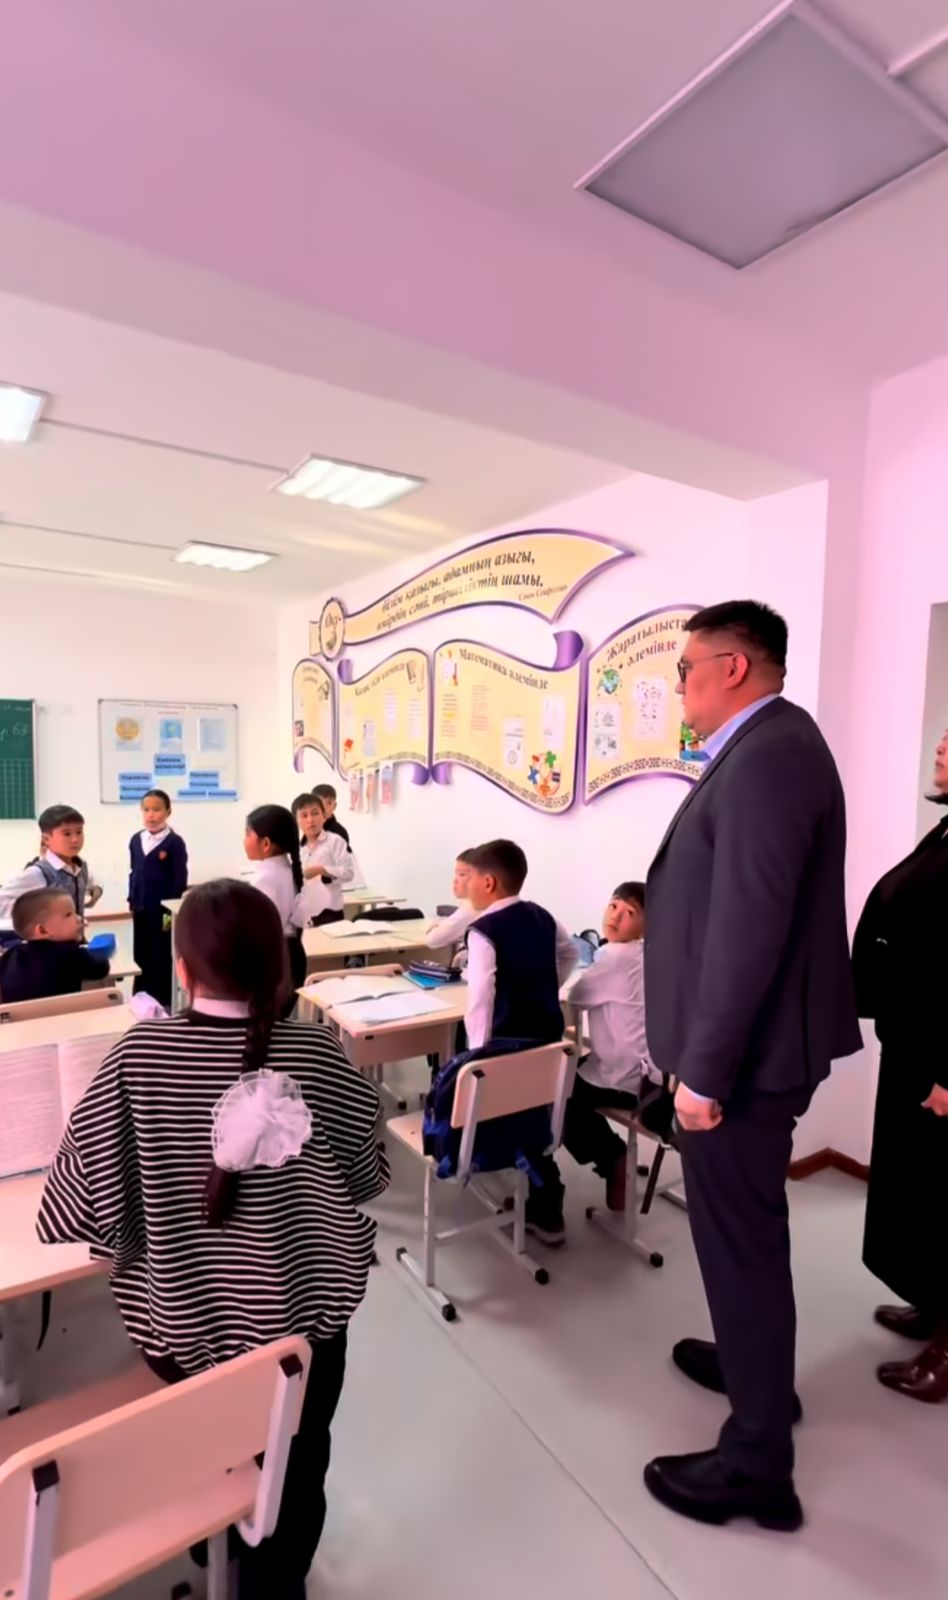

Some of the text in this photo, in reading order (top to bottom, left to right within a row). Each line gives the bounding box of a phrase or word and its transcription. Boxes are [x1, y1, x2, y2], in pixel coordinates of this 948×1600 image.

[443, 557, 491, 583] адамның
[494, 551, 535, 565] азығы,
[502, 574, 543, 587] шамы.
[606, 618, 689, 662] Жаратылыста
[459, 648, 508, 676] Математика
